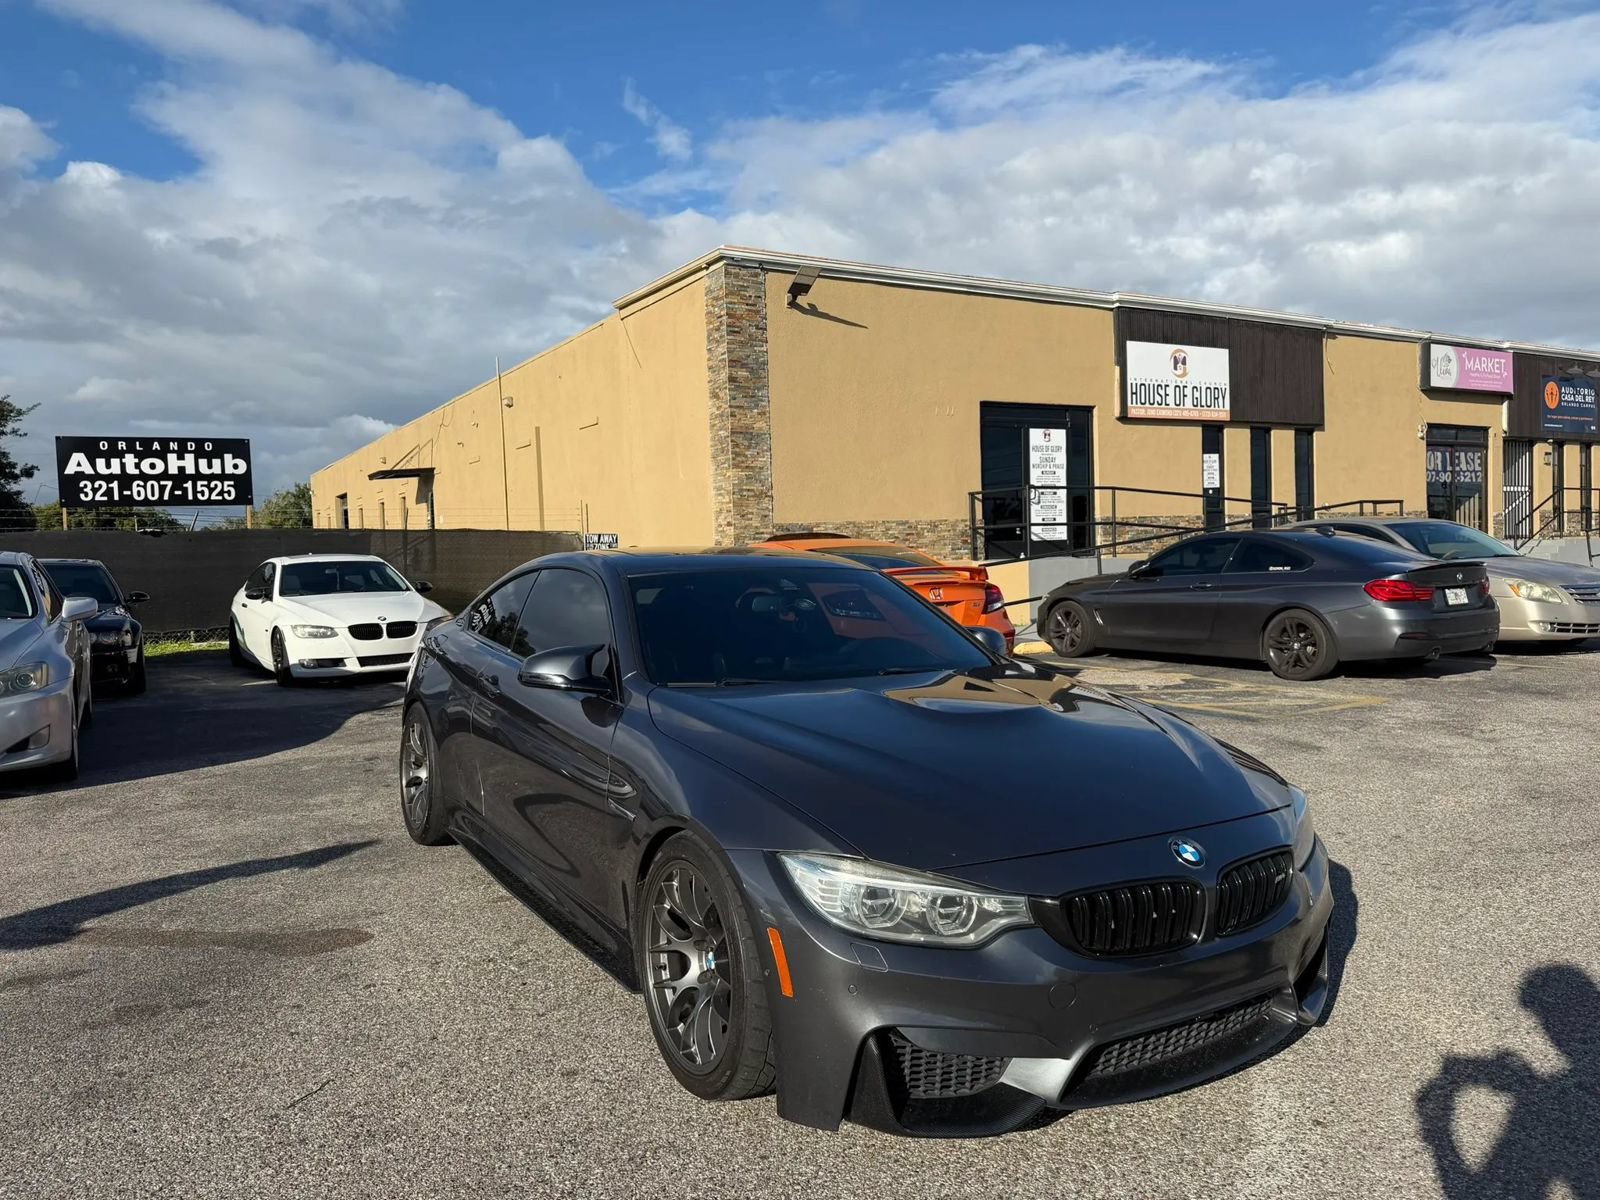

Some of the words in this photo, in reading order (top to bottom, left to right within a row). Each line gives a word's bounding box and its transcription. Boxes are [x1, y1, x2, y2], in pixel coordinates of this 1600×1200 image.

[1465, 356, 1506, 374] MARKET
[1130, 382, 1170, 407] HOUSE
[1174, 385, 1188, 407] OF
[1192, 385, 1227, 409] GLORY
[99, 440, 213, 451] ORLANDO
[63, 452, 248, 475] AutoHub
[1446, 451, 1482, 471] LEASE
[79, 480, 236, 501] 321-607-1525
[587, 535, 598, 543] TOW
[600, 535, 616, 543] AWAY
